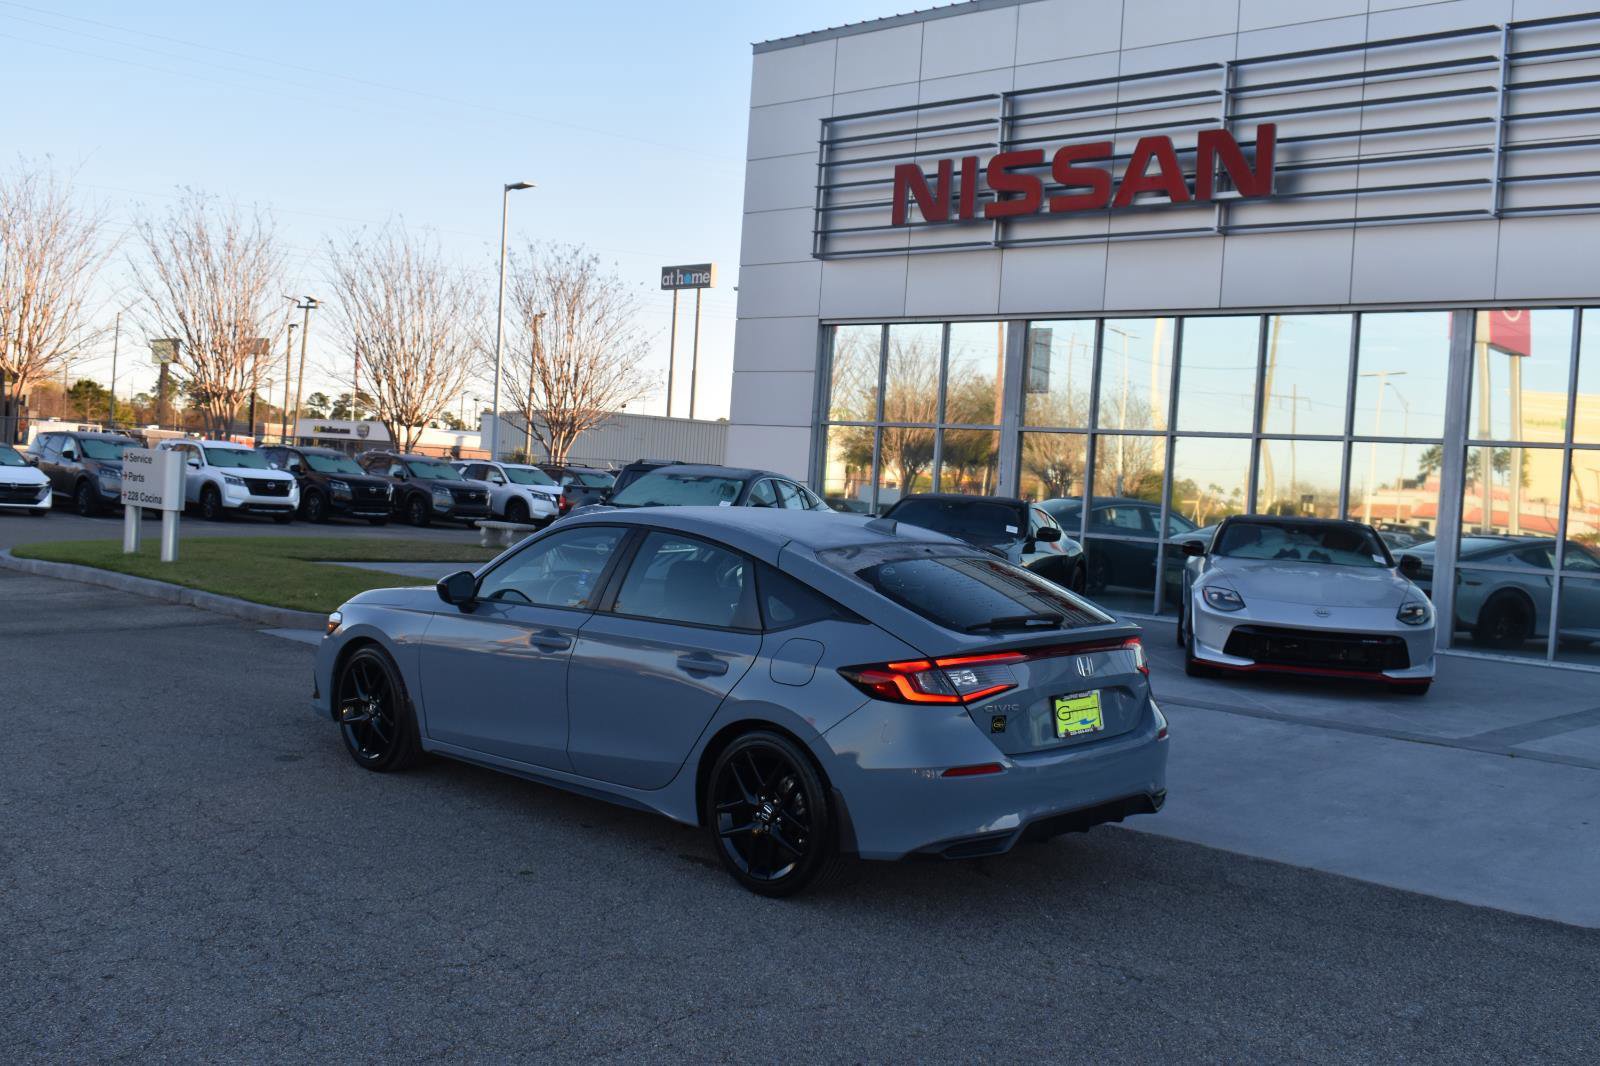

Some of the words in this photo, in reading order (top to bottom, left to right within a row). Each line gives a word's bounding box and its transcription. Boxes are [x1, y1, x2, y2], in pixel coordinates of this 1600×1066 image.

[892, 123, 1277, 225] NISSAN
[662, 272, 674, 285] at
[676, 269, 710, 285] home
[129, 452, 152, 464] Service
[128, 471, 145, 482] Parts
[127, 491, 139, 501] 228
[140, 493, 162, 505] Cocina
[984, 703, 1020, 712] CIVIC
